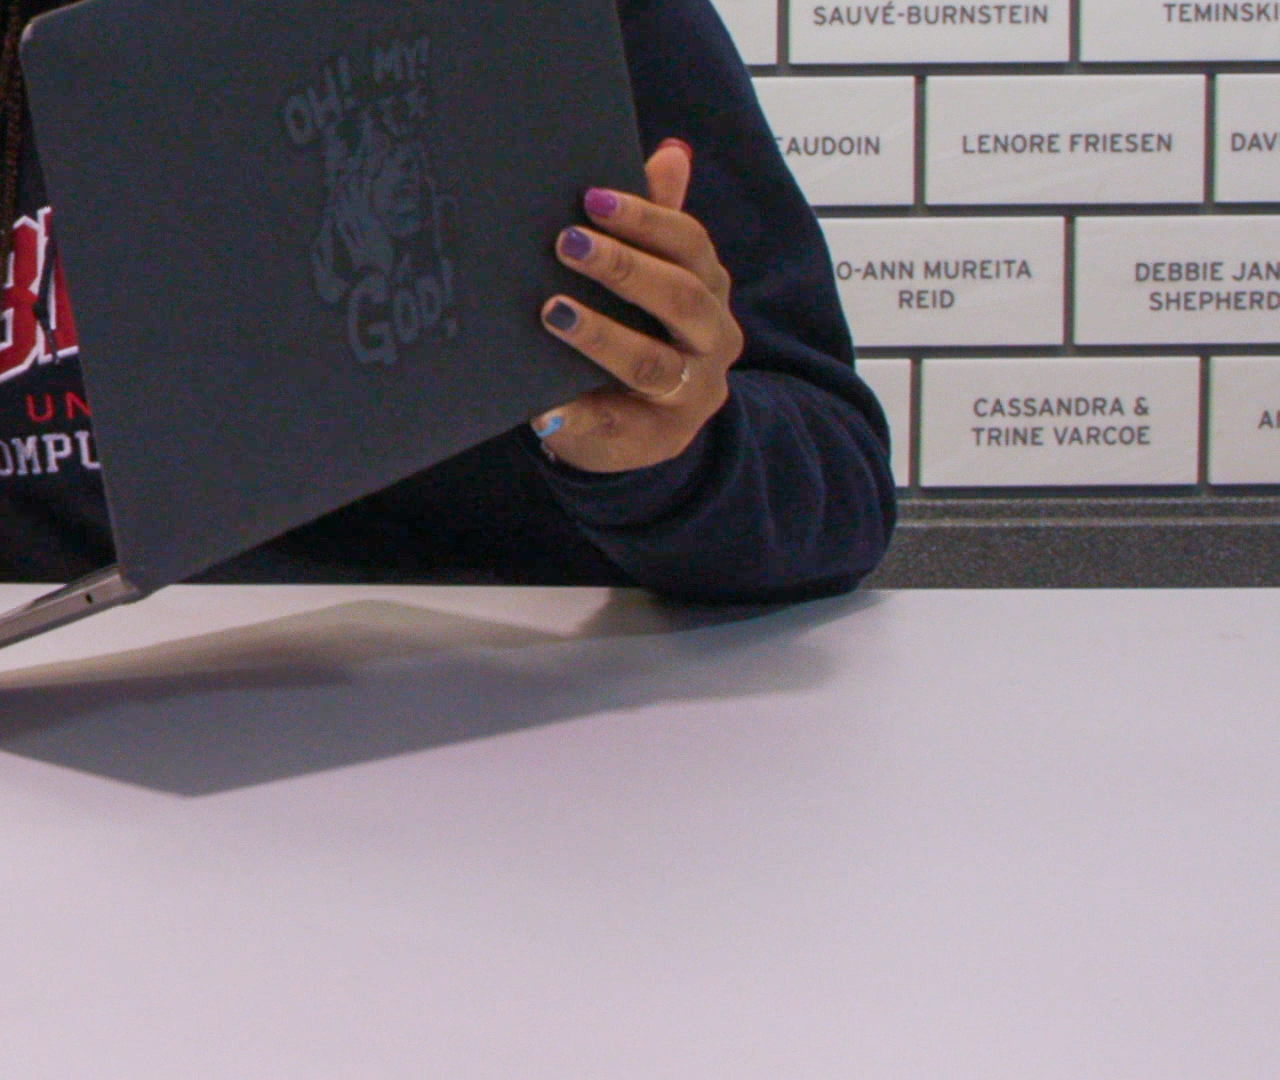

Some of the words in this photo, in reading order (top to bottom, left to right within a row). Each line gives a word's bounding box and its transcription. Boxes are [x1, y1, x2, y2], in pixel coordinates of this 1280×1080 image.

[813, 0, 1049, 27] SAUVÉ-BURNSTEIN
[962, 133, 1061, 155] LENORE
[1069, 132, 1173, 154] FRIESEN
[923, 259, 1032, 280] MUREITA
[1135, 261, 1224, 283] DEBBIE
[898, 288, 956, 310] REID
[1149, 290, 1280, 312] SHEPHERD
[973, 396, 1125, 418] CASSANDRA
[971, 426, 1044, 447] TRINE
[1052, 425, 1151, 446] VARCOE
